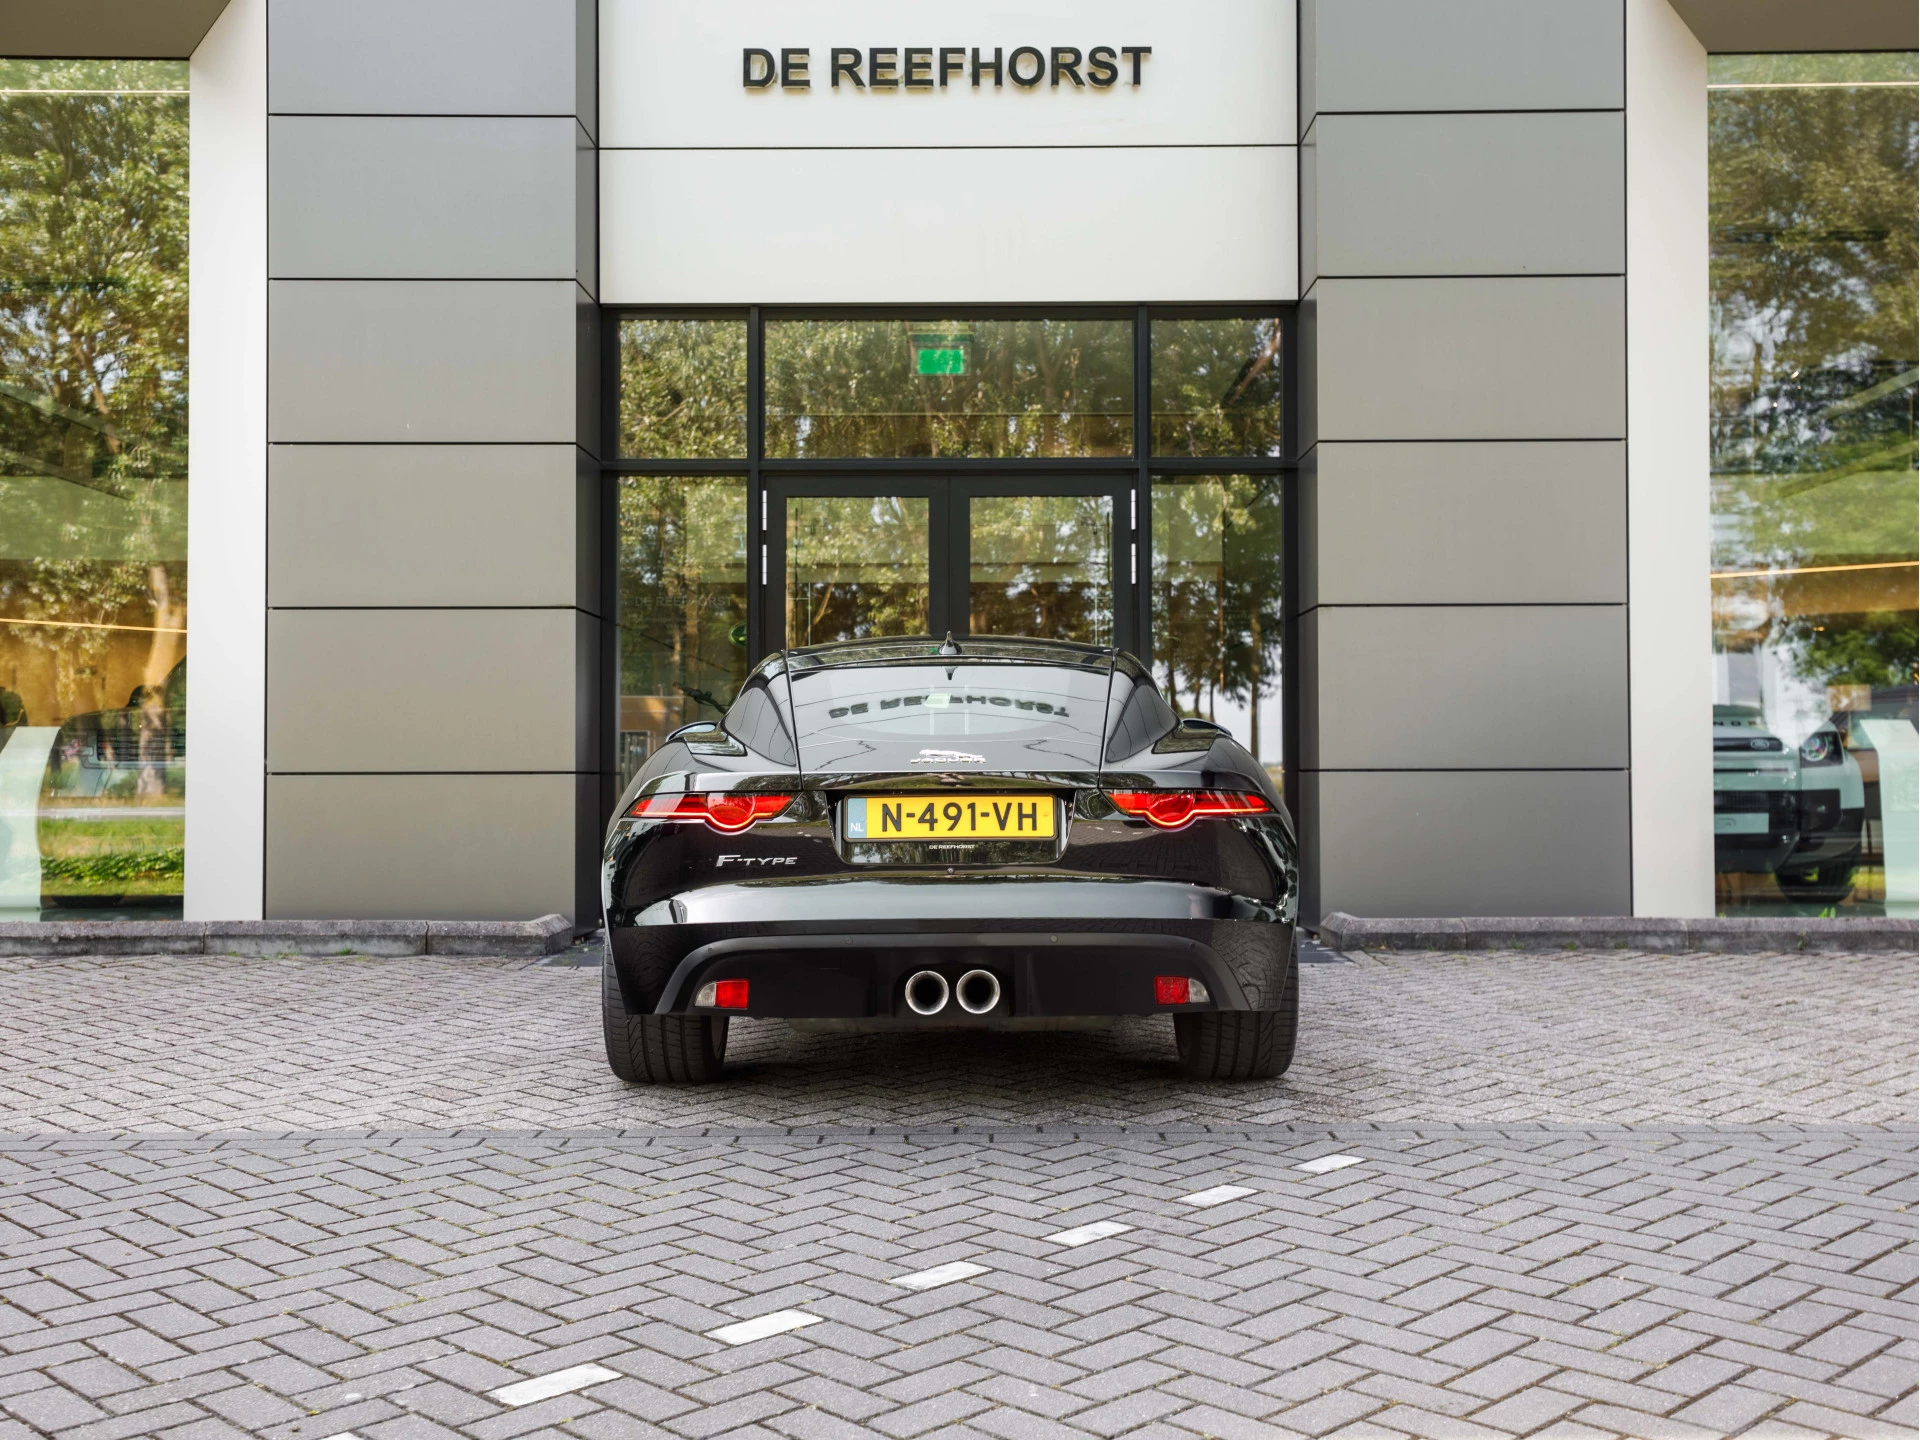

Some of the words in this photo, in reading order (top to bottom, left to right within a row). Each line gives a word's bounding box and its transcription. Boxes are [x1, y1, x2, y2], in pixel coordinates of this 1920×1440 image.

[743, 48, 811, 88] DE
[831, 46, 1152, 88] REEFHORST
[655, 596, 732, 607] REEFORST
[881, 802, 1038, 832] N-491-VH
[850, 822, 864, 832] NL
[716, 854, 798, 867] F-TYPE
